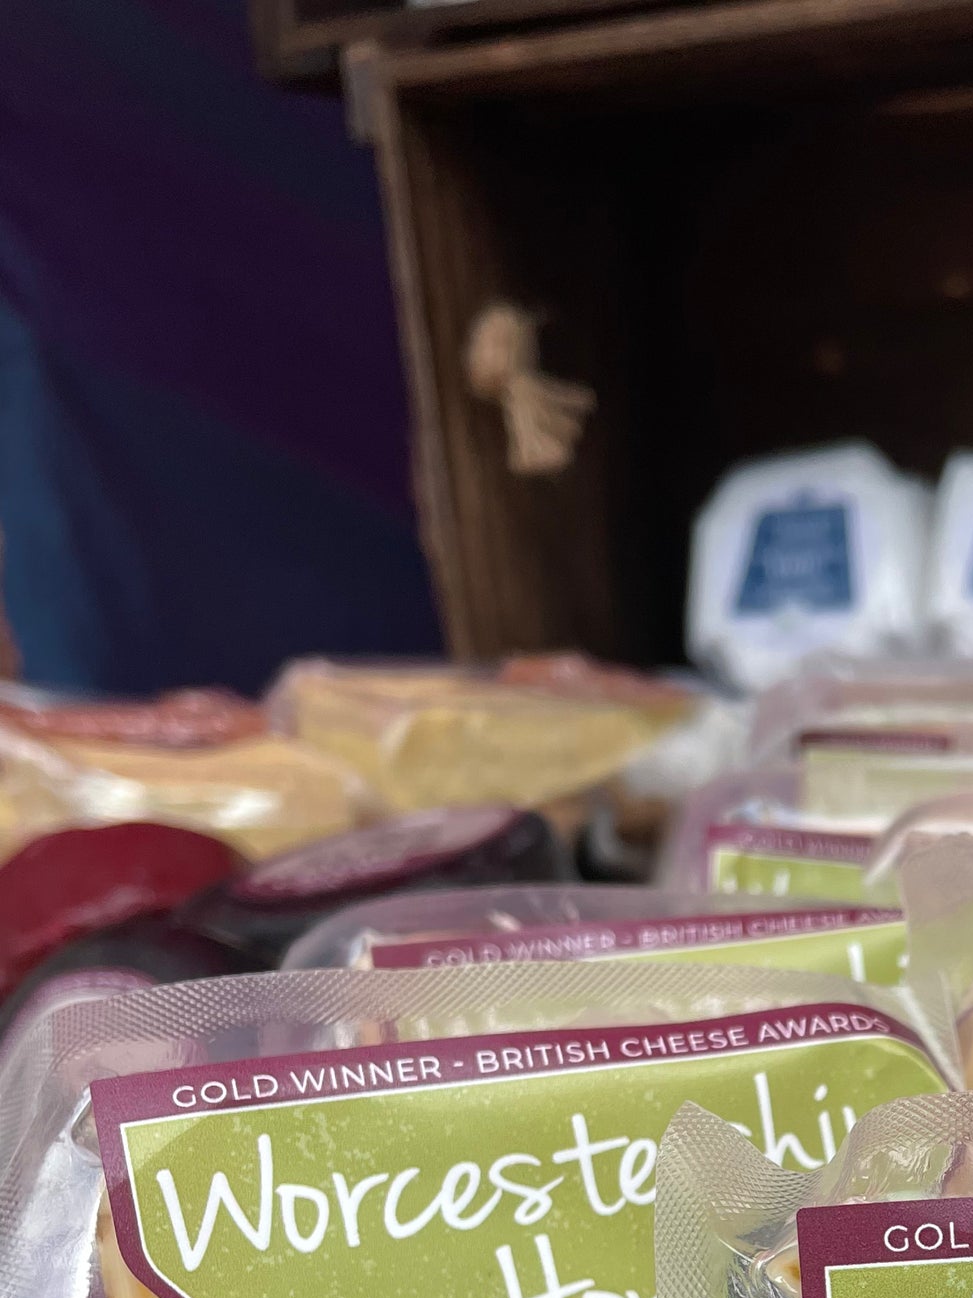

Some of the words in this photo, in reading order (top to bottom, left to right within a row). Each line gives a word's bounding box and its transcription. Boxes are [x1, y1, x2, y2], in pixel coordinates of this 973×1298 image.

[172, 1074, 279, 1108] GOLD
[290, 1056, 442, 1095] WINNER
[475, 1040, 610, 1074] BRITISH
[619, 1026, 749, 1059] CHEESE
[757, 1012, 890, 1044] AWARDS
